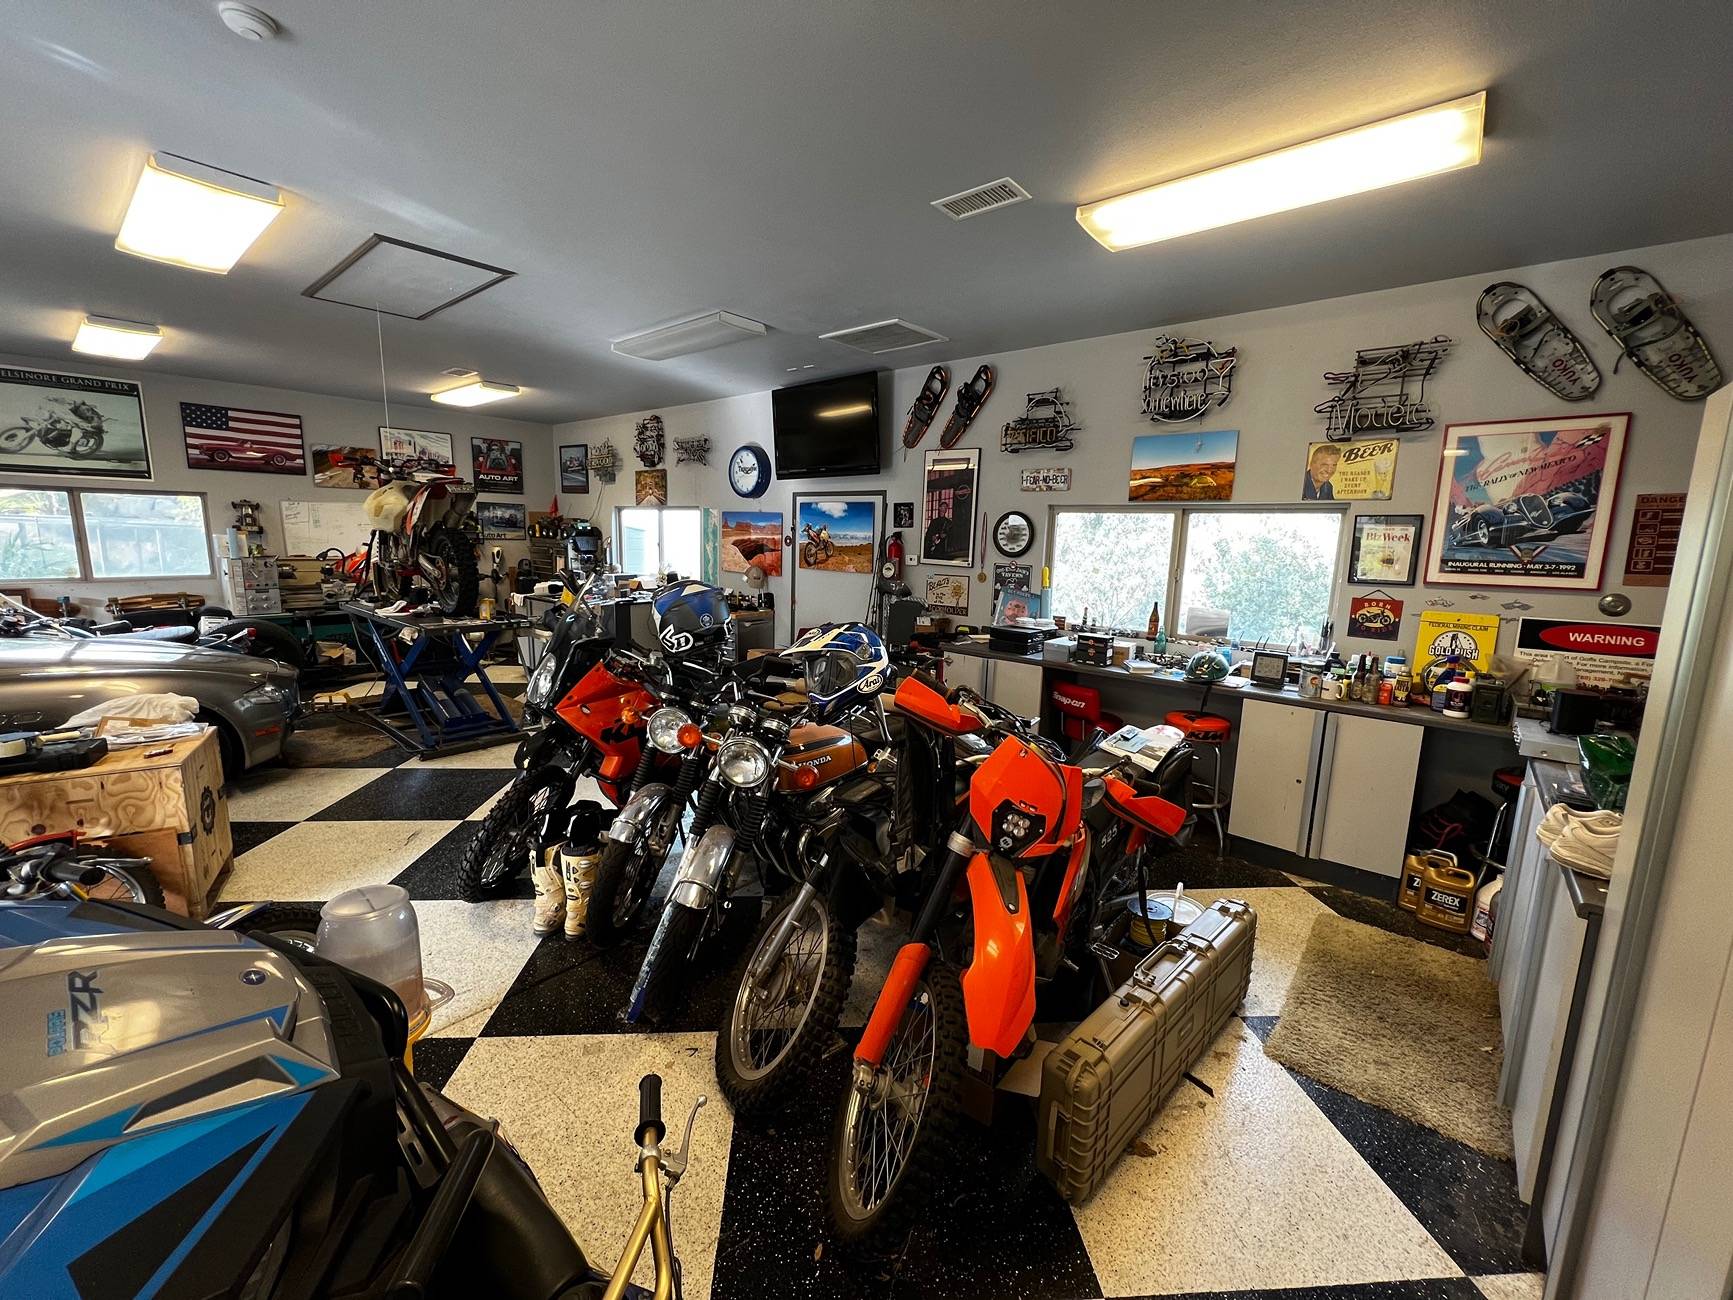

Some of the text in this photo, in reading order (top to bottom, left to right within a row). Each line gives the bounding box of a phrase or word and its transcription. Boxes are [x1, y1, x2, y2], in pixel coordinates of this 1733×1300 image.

[1552, 358, 1580, 385] YUKO
[1668, 353, 1698, 383] YUKO
[1, 369, 59, 382] ELSINORE
[60, 376, 101, 387] GRAND
[105, 381, 129, 390] PRIX
[1342, 442, 1394, 463] BEER
[1539, 454, 1577, 470] MEXICO
[1364, 601, 1391, 609] BORN
[1471, 624, 1489, 632] CLAIM
[1568, 632, 1646, 647] WARNING
[1428, 645, 1452, 656] GOLD
[1431, 890, 1460, 907] ZEREX
